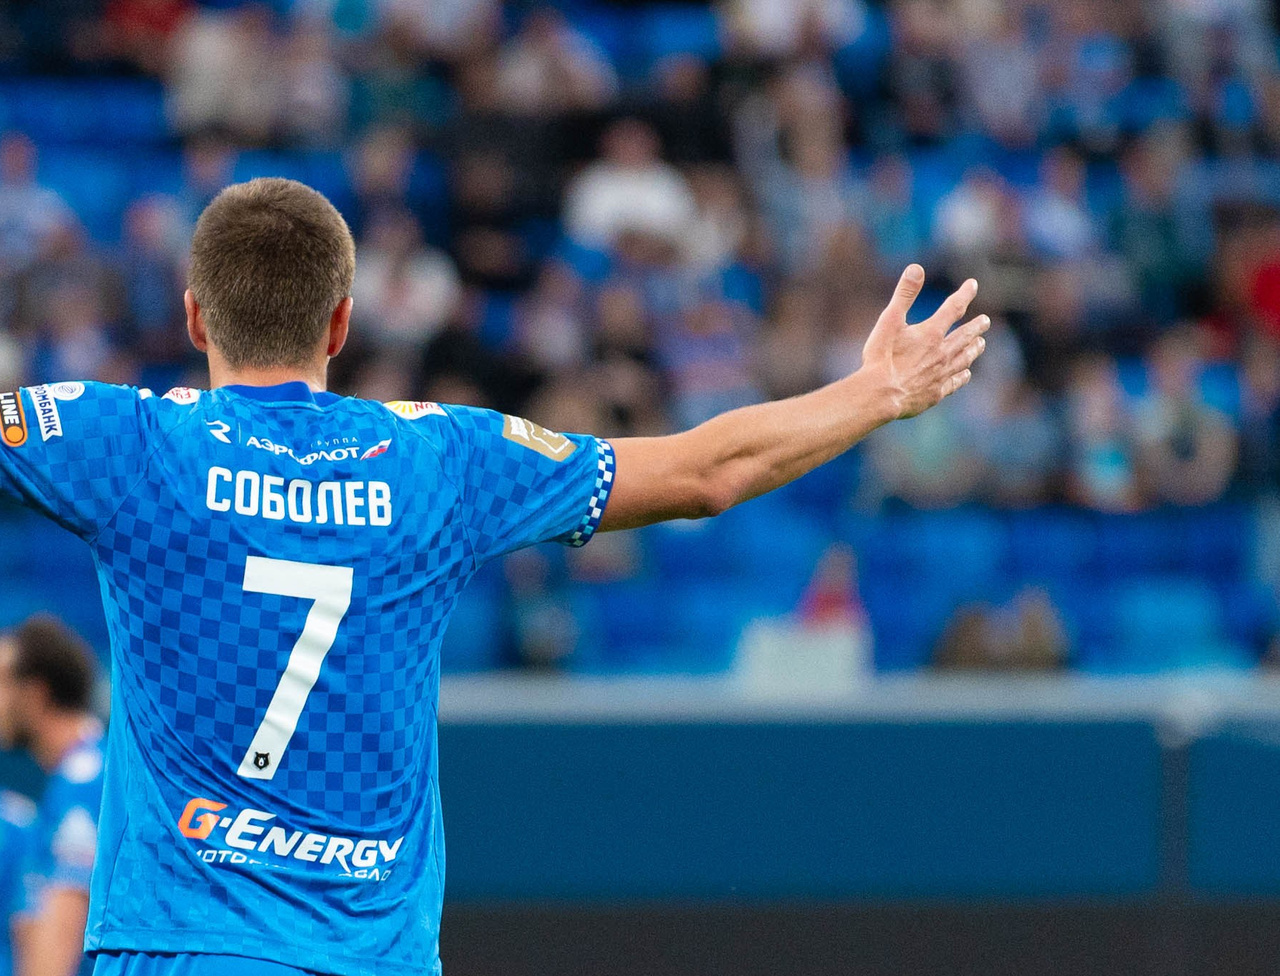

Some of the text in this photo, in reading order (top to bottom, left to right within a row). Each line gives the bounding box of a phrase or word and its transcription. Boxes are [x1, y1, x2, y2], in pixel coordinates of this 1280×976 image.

[0, 392, 20, 425] LINE
[206, 466, 392, 526] СОБОЛЕВ
[237, 555, 354, 780] 7
